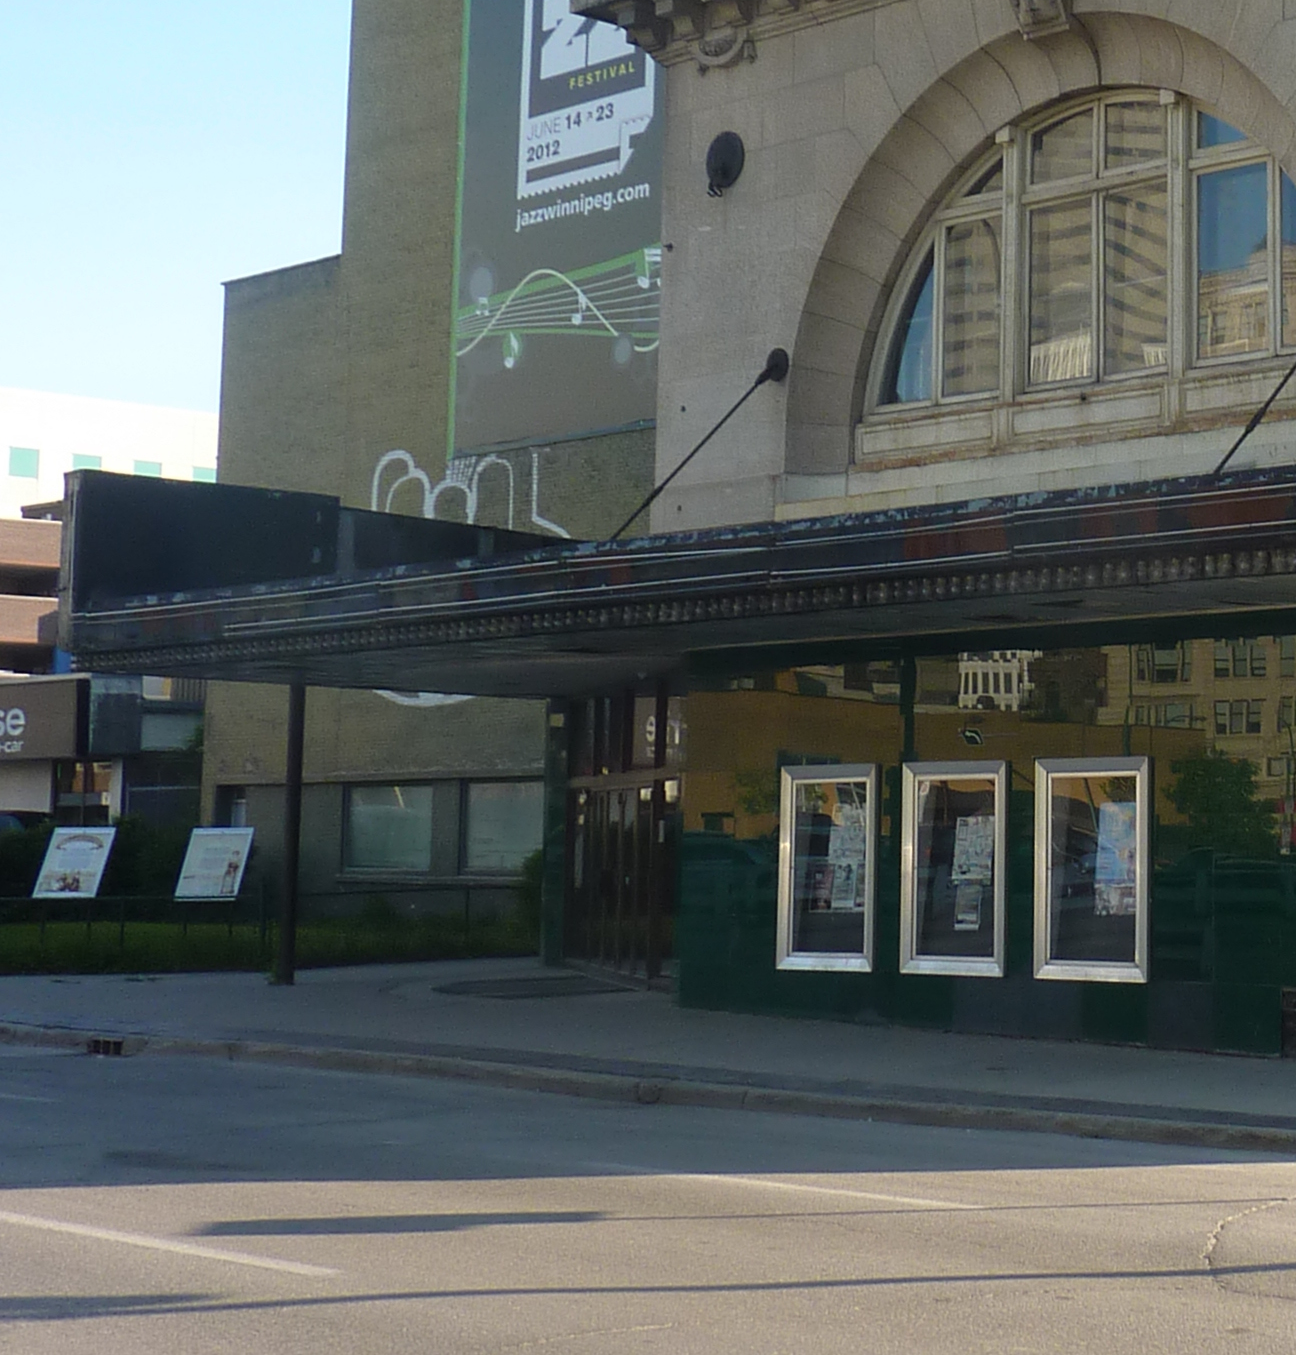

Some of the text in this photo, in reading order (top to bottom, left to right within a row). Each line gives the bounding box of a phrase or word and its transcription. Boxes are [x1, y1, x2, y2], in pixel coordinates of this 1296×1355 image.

[569, 61, 636, 91] FESTIVAL
[526, 102, 615, 141] JUNE 14 23
[526, 139, 561, 163] 2012
[515, 182, 651, 233] jazzwinnipeg.com
